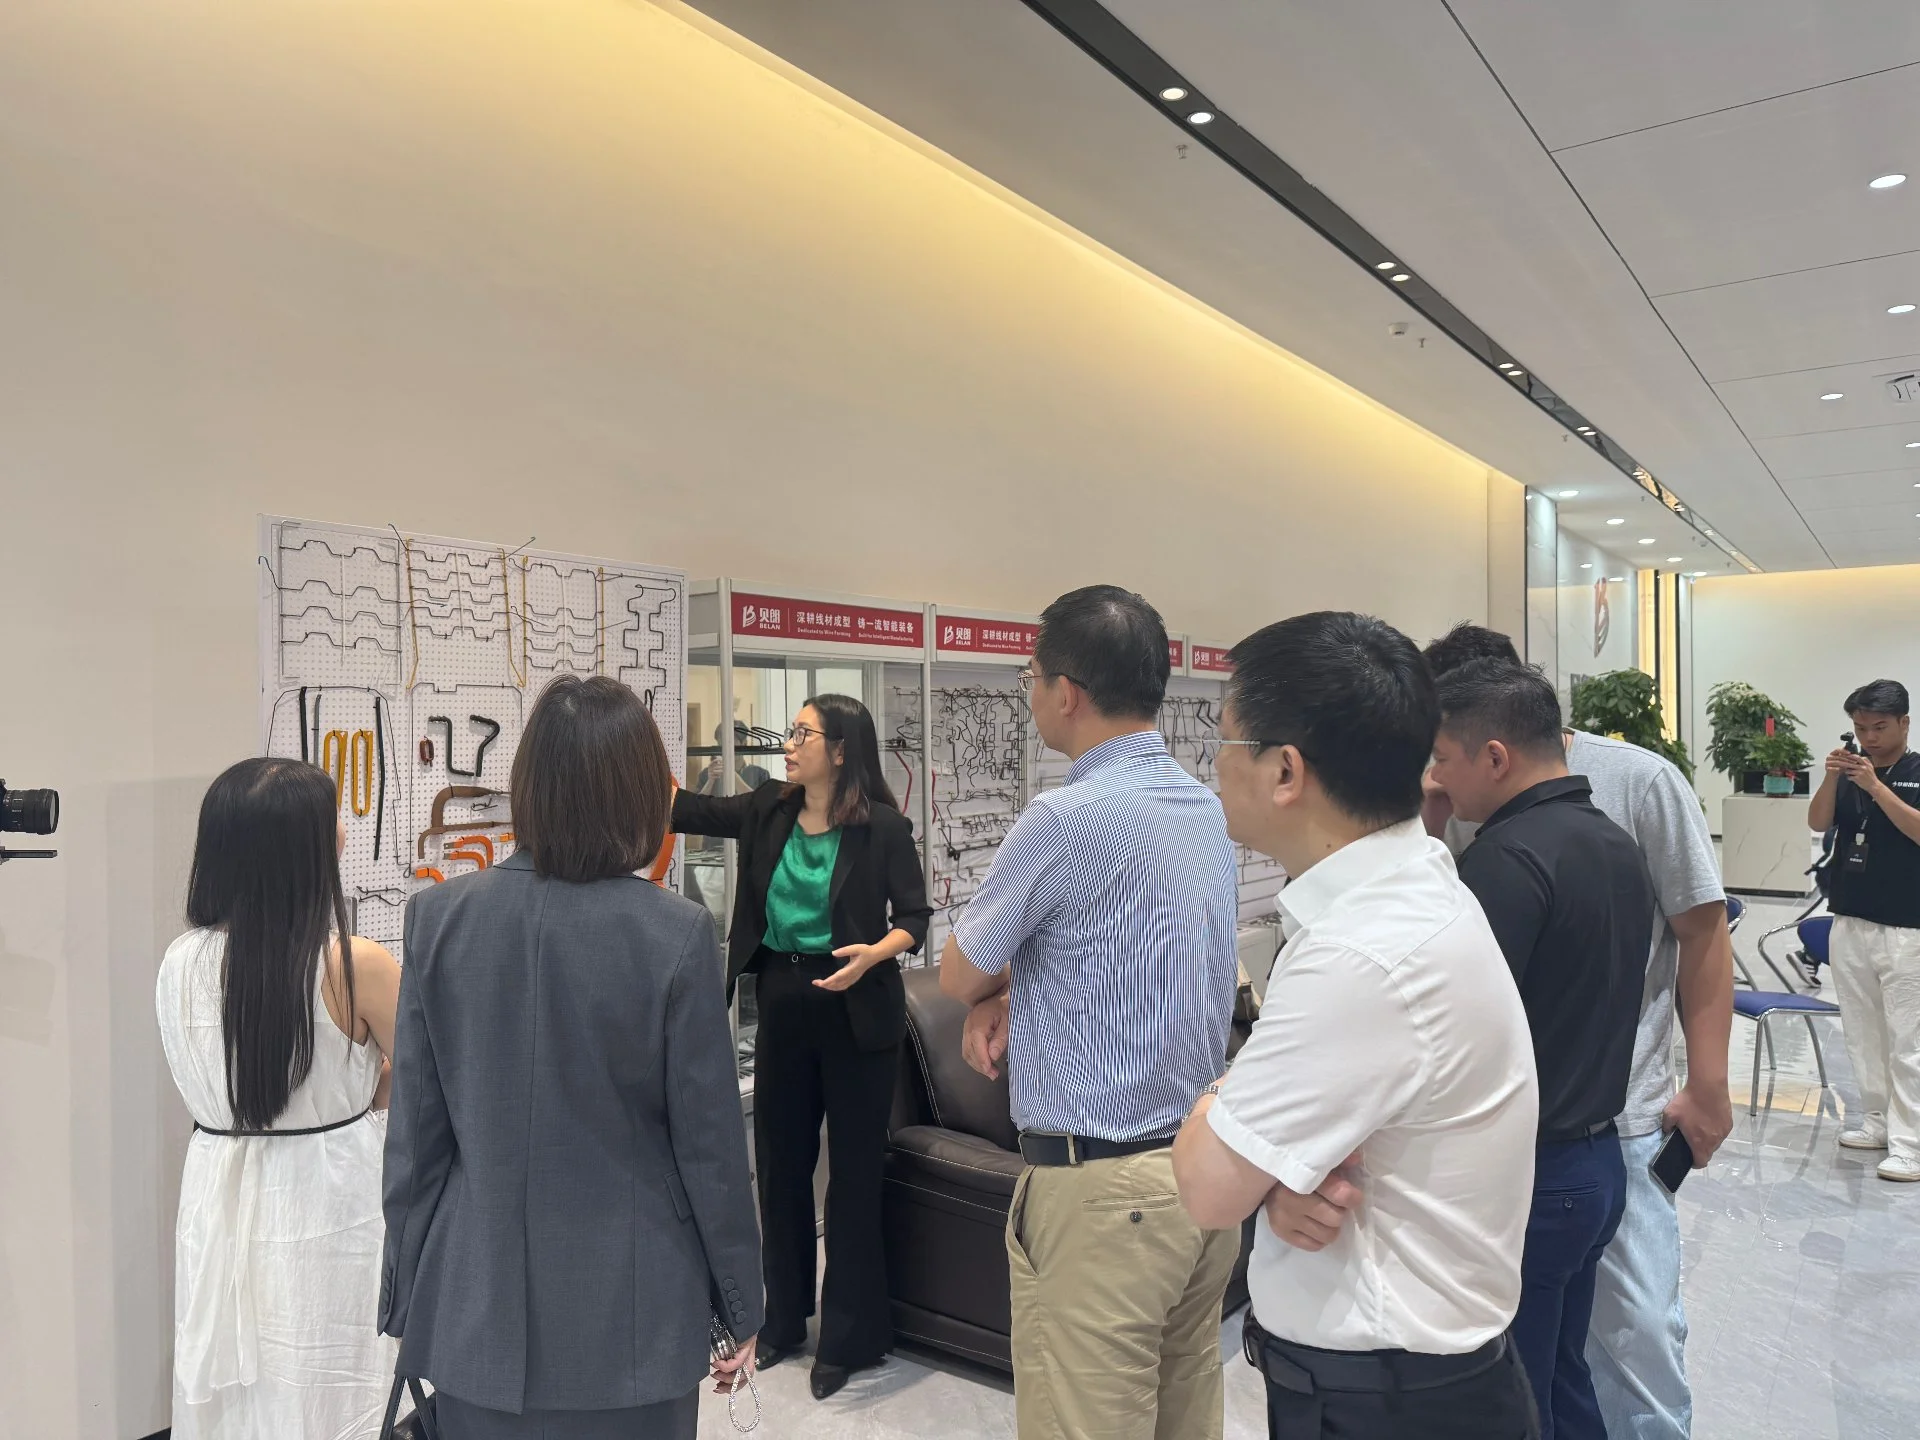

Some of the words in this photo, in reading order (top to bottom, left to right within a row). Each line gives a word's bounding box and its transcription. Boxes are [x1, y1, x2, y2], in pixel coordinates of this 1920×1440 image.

[759, 608, 780, 623] 贝朗
[796, 612, 850, 627] 深耕线材成型
[857, 617, 914, 633] 铸一流智能装备
